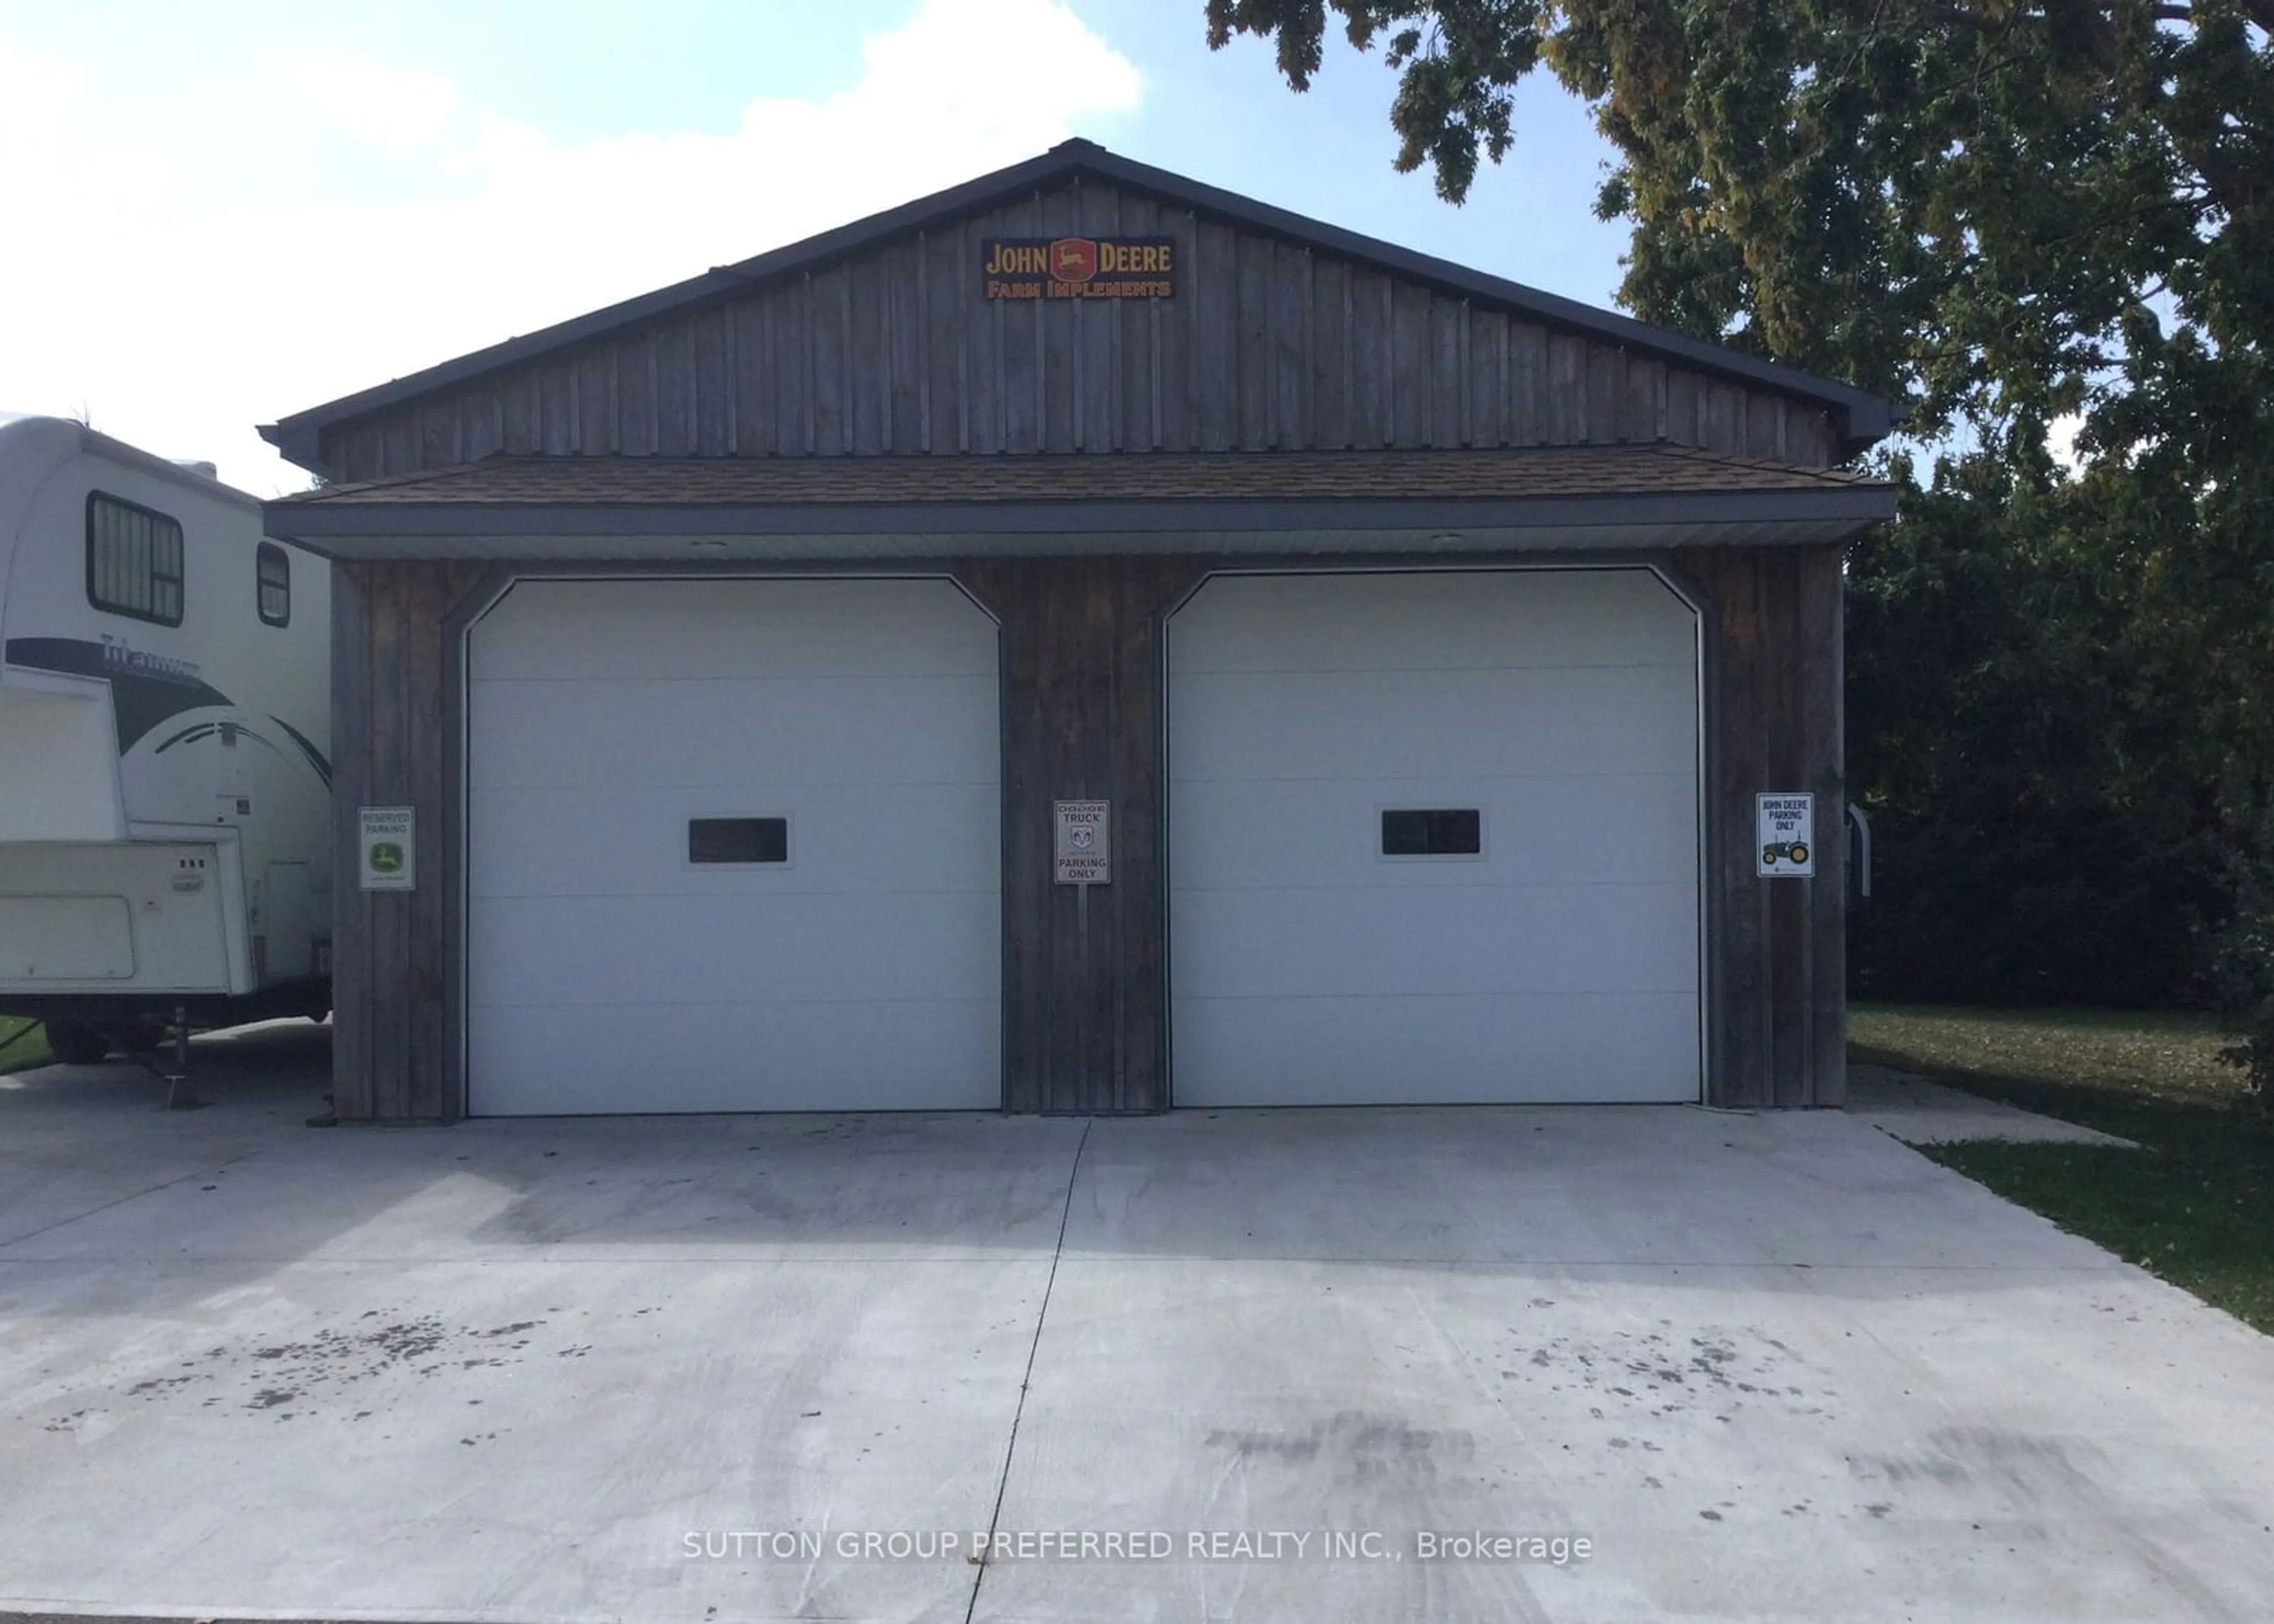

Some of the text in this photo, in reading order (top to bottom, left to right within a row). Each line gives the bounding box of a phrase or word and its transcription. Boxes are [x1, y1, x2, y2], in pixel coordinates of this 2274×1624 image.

[985, 242, 1172, 274] JOHN DEERE
[988, 281, 1171, 298] FARM IMPLEMENTS
[1762, 799, 1809, 810] JOHN DEERE
[1064, 813, 1100, 823] TRUCK
[1768, 811, 1802, 819] PARKING
[365, 824, 408, 834] PARKING
[1775, 821, 1795, 830] ONLY
[1058, 858, 1106, 868] PARKING
[1068, 869, 1096, 879] ONLY
